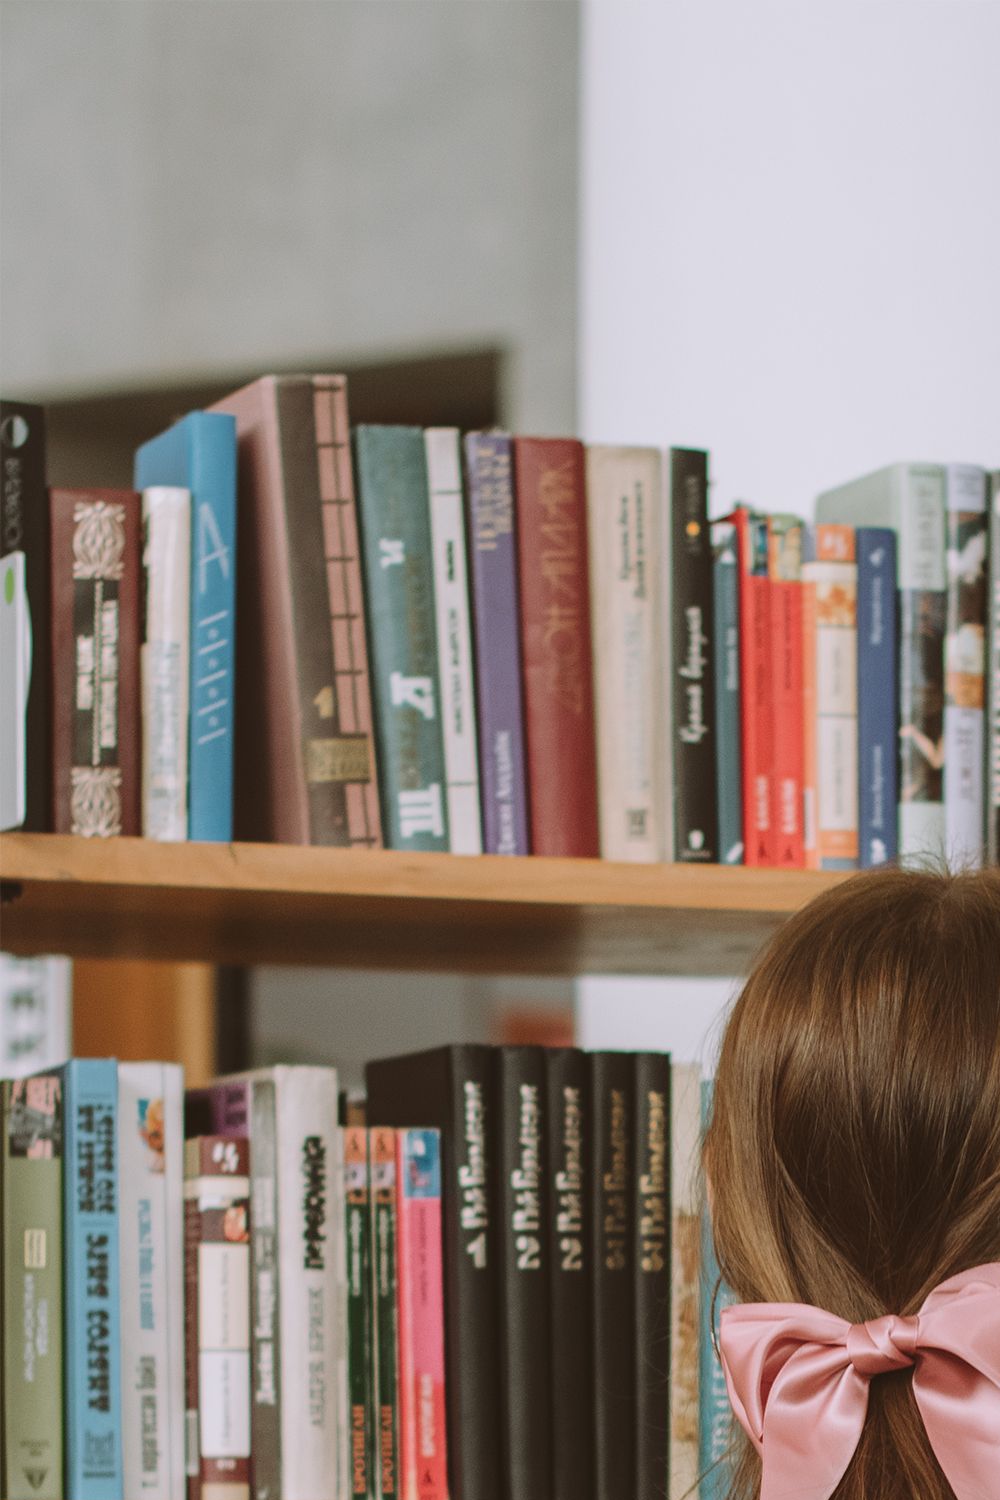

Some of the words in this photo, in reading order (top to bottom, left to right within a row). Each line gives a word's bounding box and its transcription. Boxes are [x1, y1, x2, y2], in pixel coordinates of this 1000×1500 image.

[85, 1233, 109, 1299] БИРС
[308, 1286, 326, 1353] БРИНК
[85, 1310, 110, 1413] АМБРОЗ
[309, 1360, 328, 1429] АНДРЕ
[352, 1404, 367, 1495] БРОТИГАН
[380, 1404, 394, 1495] БРОТИГАН
